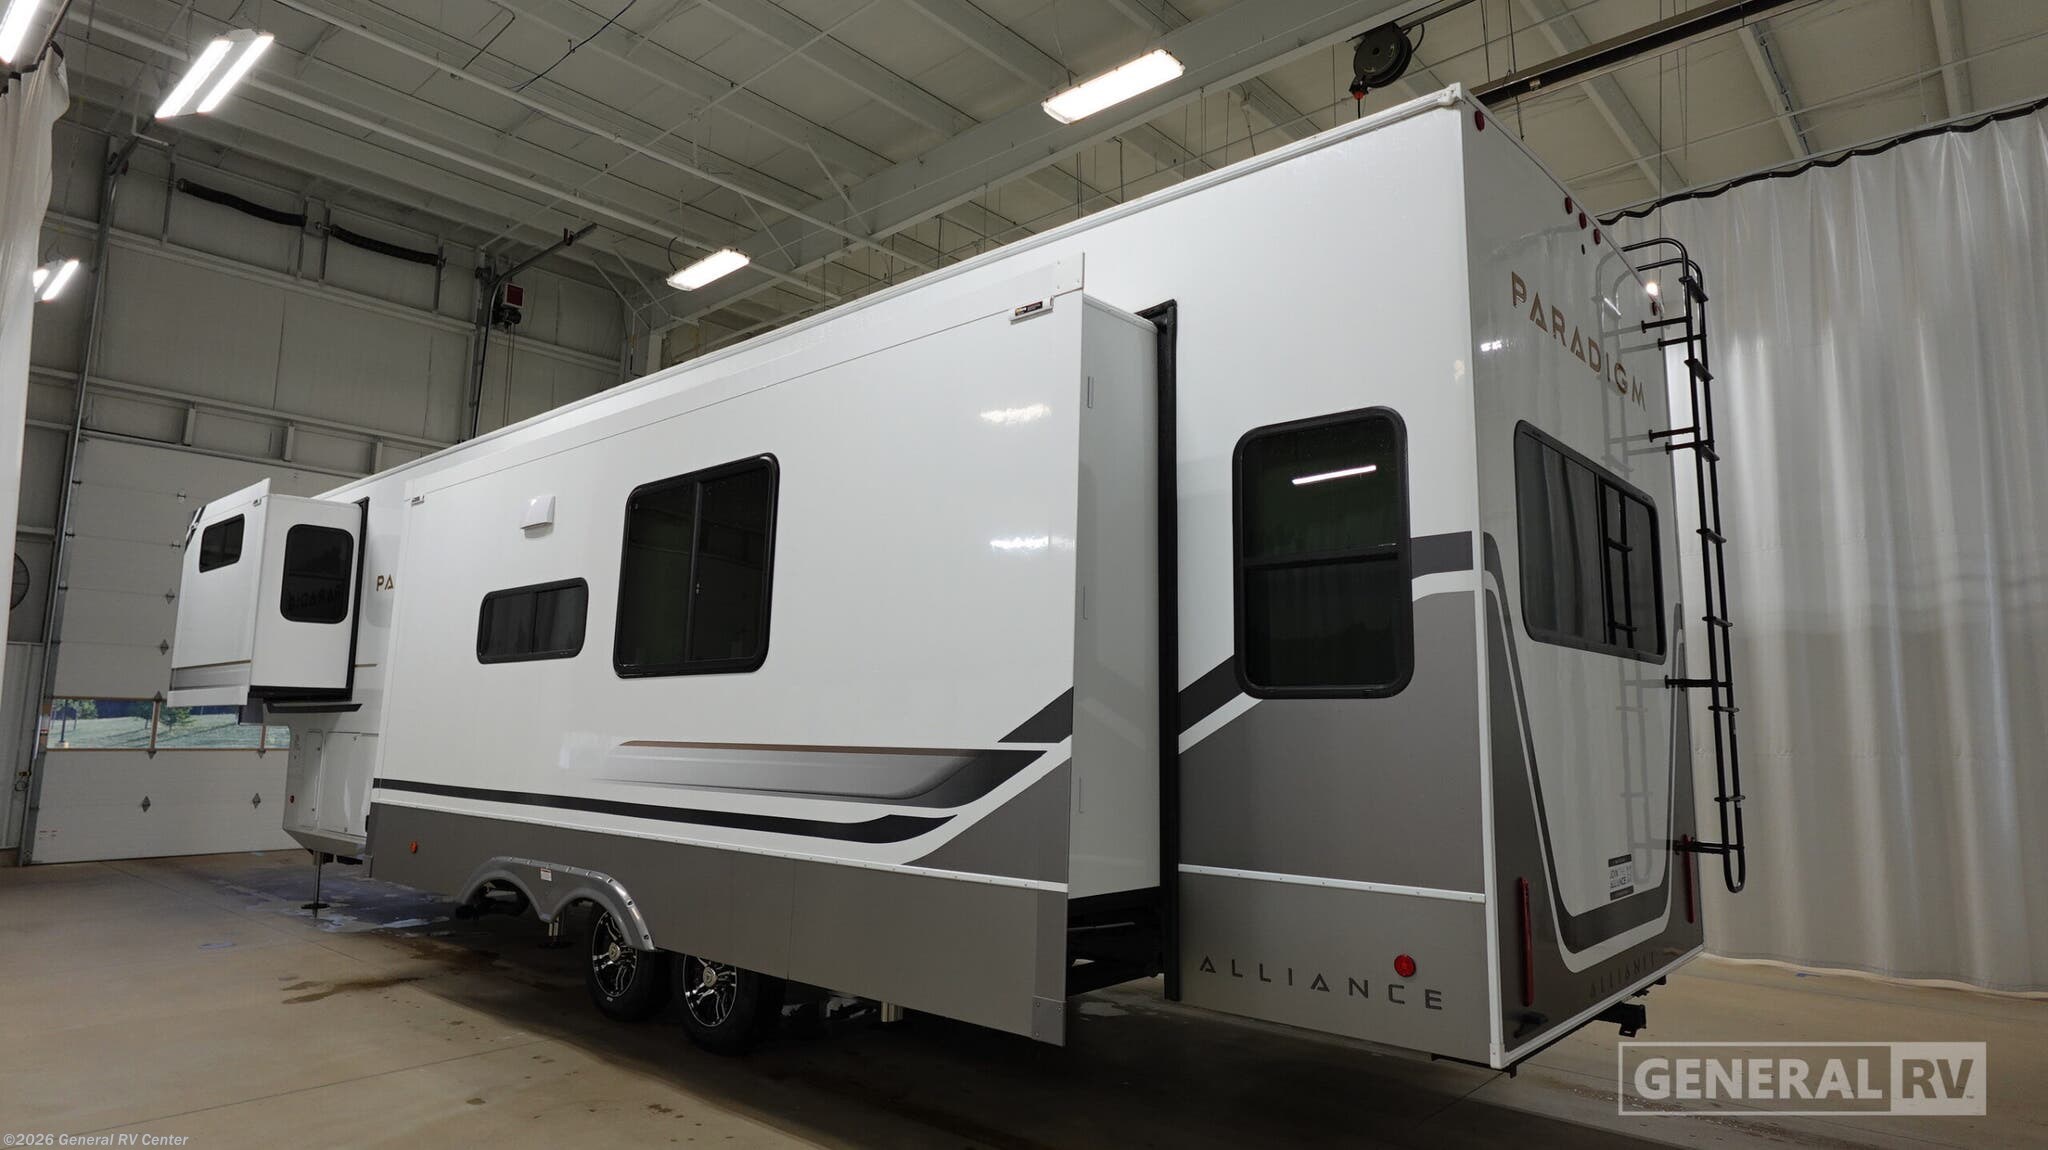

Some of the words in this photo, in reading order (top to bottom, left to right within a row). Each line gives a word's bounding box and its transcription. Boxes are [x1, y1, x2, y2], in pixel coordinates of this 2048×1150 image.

[1511, 271, 1646, 411] PARADIGM
[376, 574, 394, 591] PA
[1199, 956, 1442, 1010] ALLIANCE
